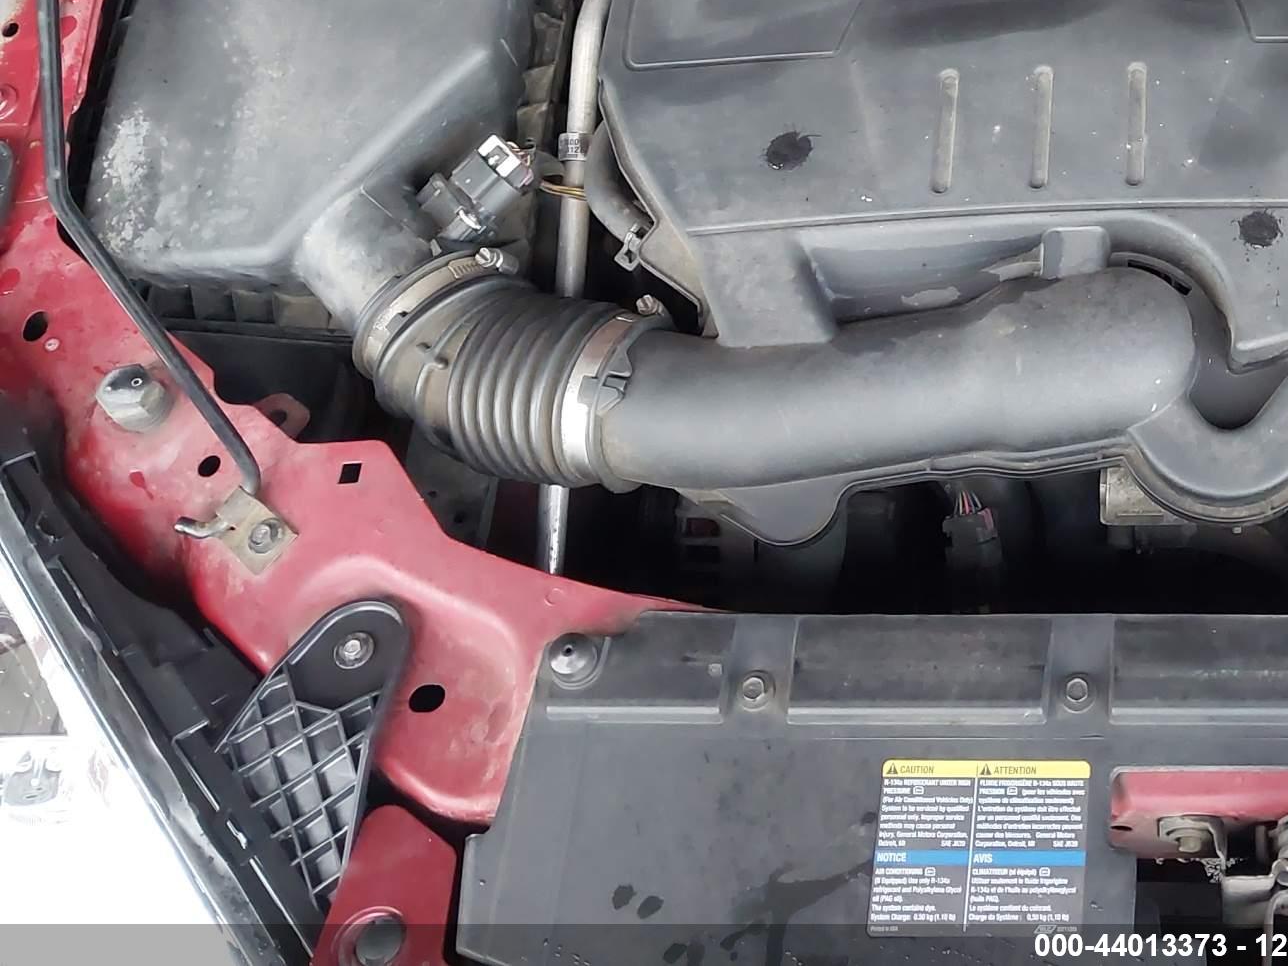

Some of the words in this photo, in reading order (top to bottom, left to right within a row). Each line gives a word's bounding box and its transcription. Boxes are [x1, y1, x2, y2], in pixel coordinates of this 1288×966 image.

[900, 765, 935, 774] CAUTION
[994, 766, 1037, 775] ATTENTION
[876, 852, 907, 862] NOTICE
[973, 853, 993, 863] AVIS
